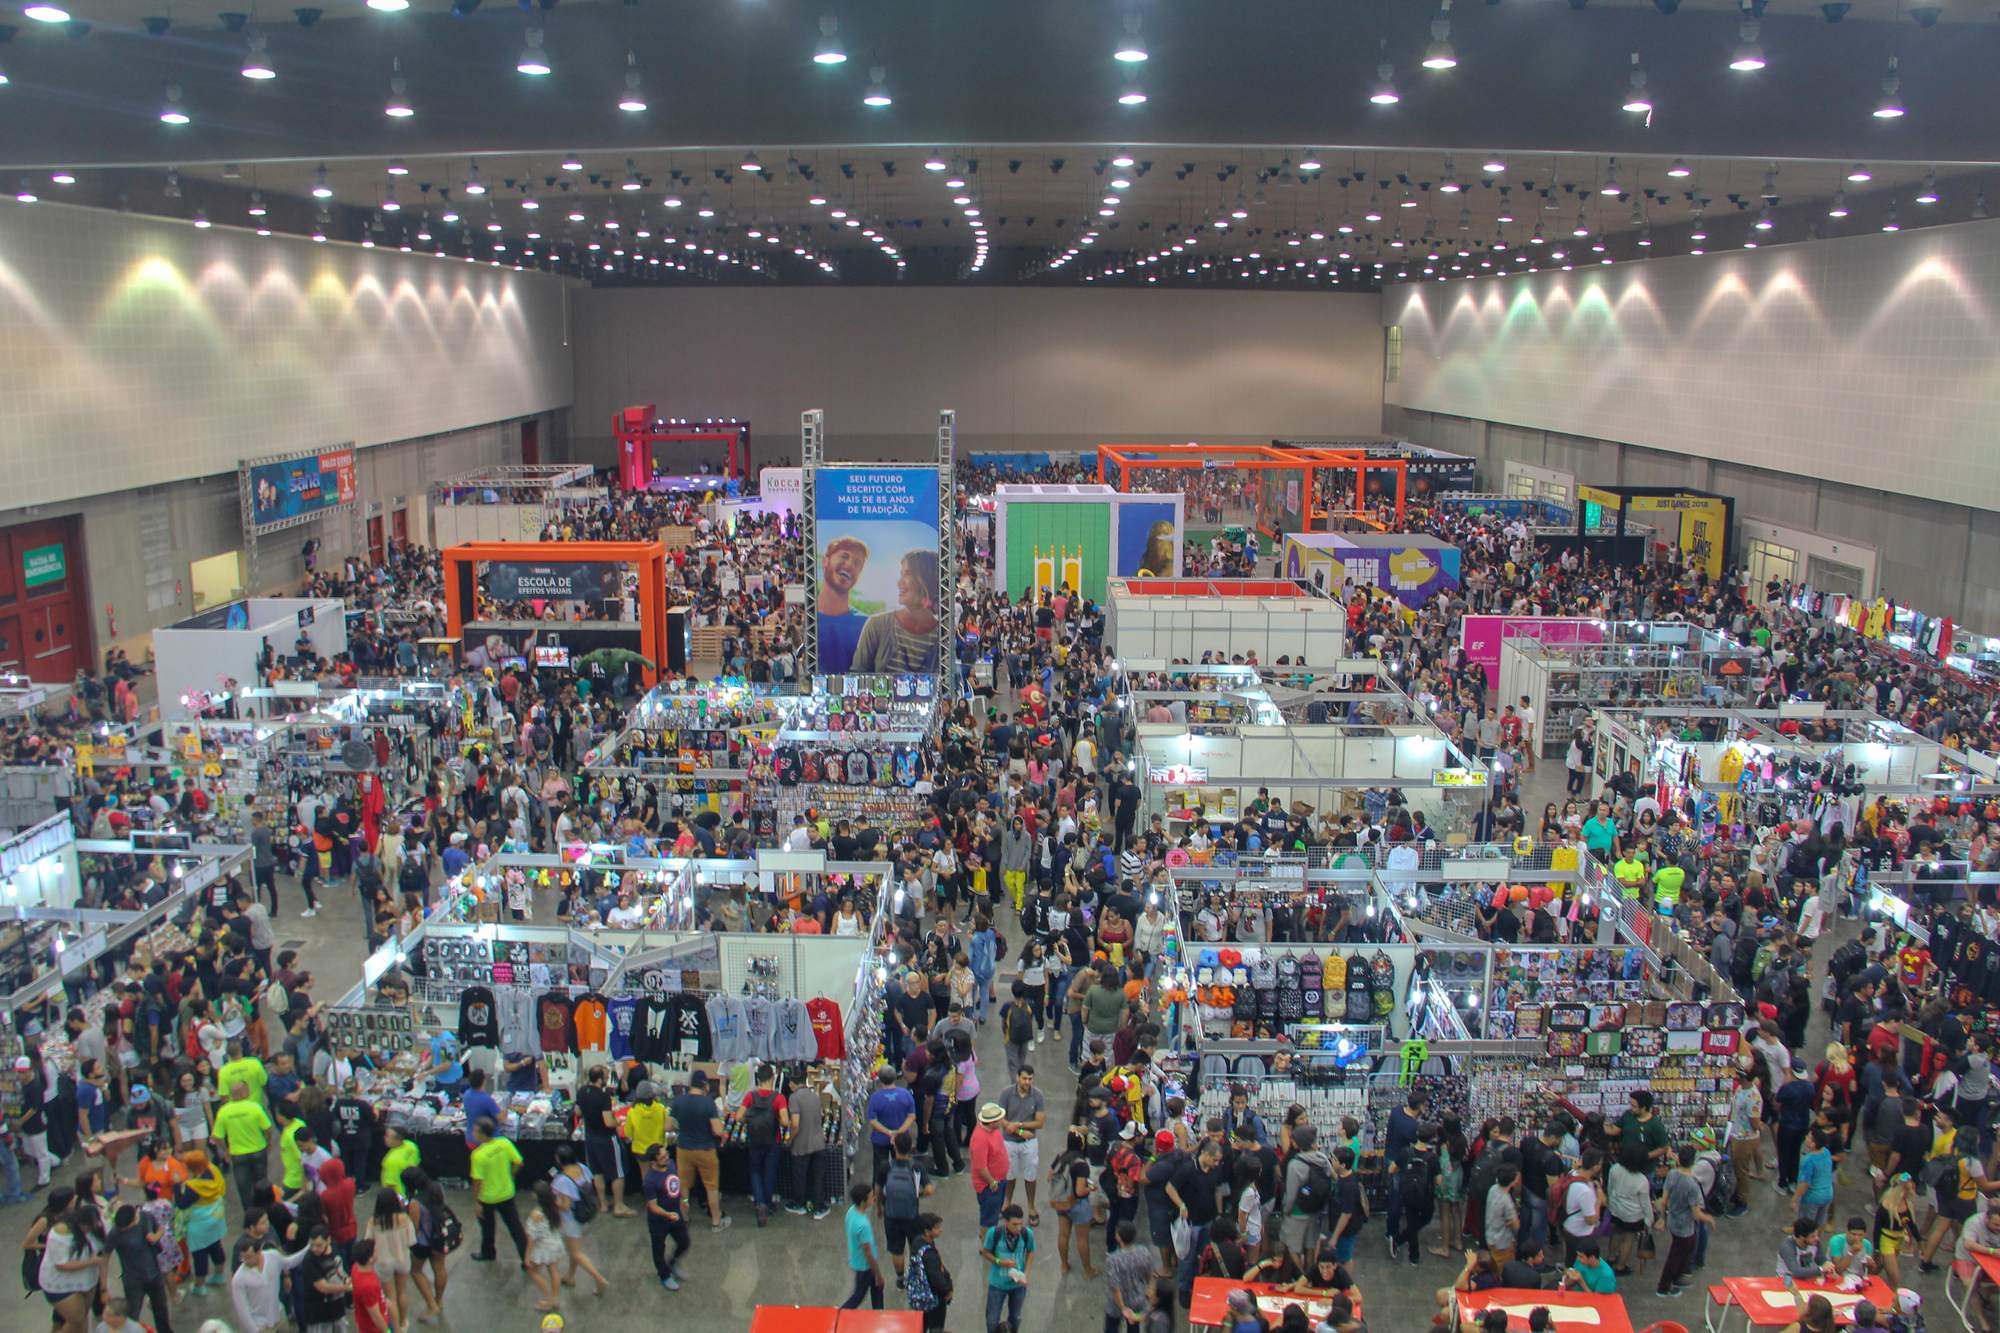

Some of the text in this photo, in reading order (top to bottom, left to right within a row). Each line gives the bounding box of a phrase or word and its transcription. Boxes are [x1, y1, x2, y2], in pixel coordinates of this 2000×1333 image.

[849, 475, 903, 484] SEU FUTURO
[846, 485, 906, 494] ESCRITO COM
[838, 495, 860, 504] MAIS
[862, 495, 874, 504] DE
[889, 495, 915, 504] ANOS
[1656, 499, 1670, 508] JUST
[1671, 500, 1690, 509] DANCE
[847, 504, 908, 516] DE TRADIÇÃO.
[1692, 519, 1707, 539] JUST
[518, 577, 572, 587] ESCOLA DE
[517, 587, 573, 595] EFEITOS VISUAIS
[1471, 641, 1485, 650] EF
